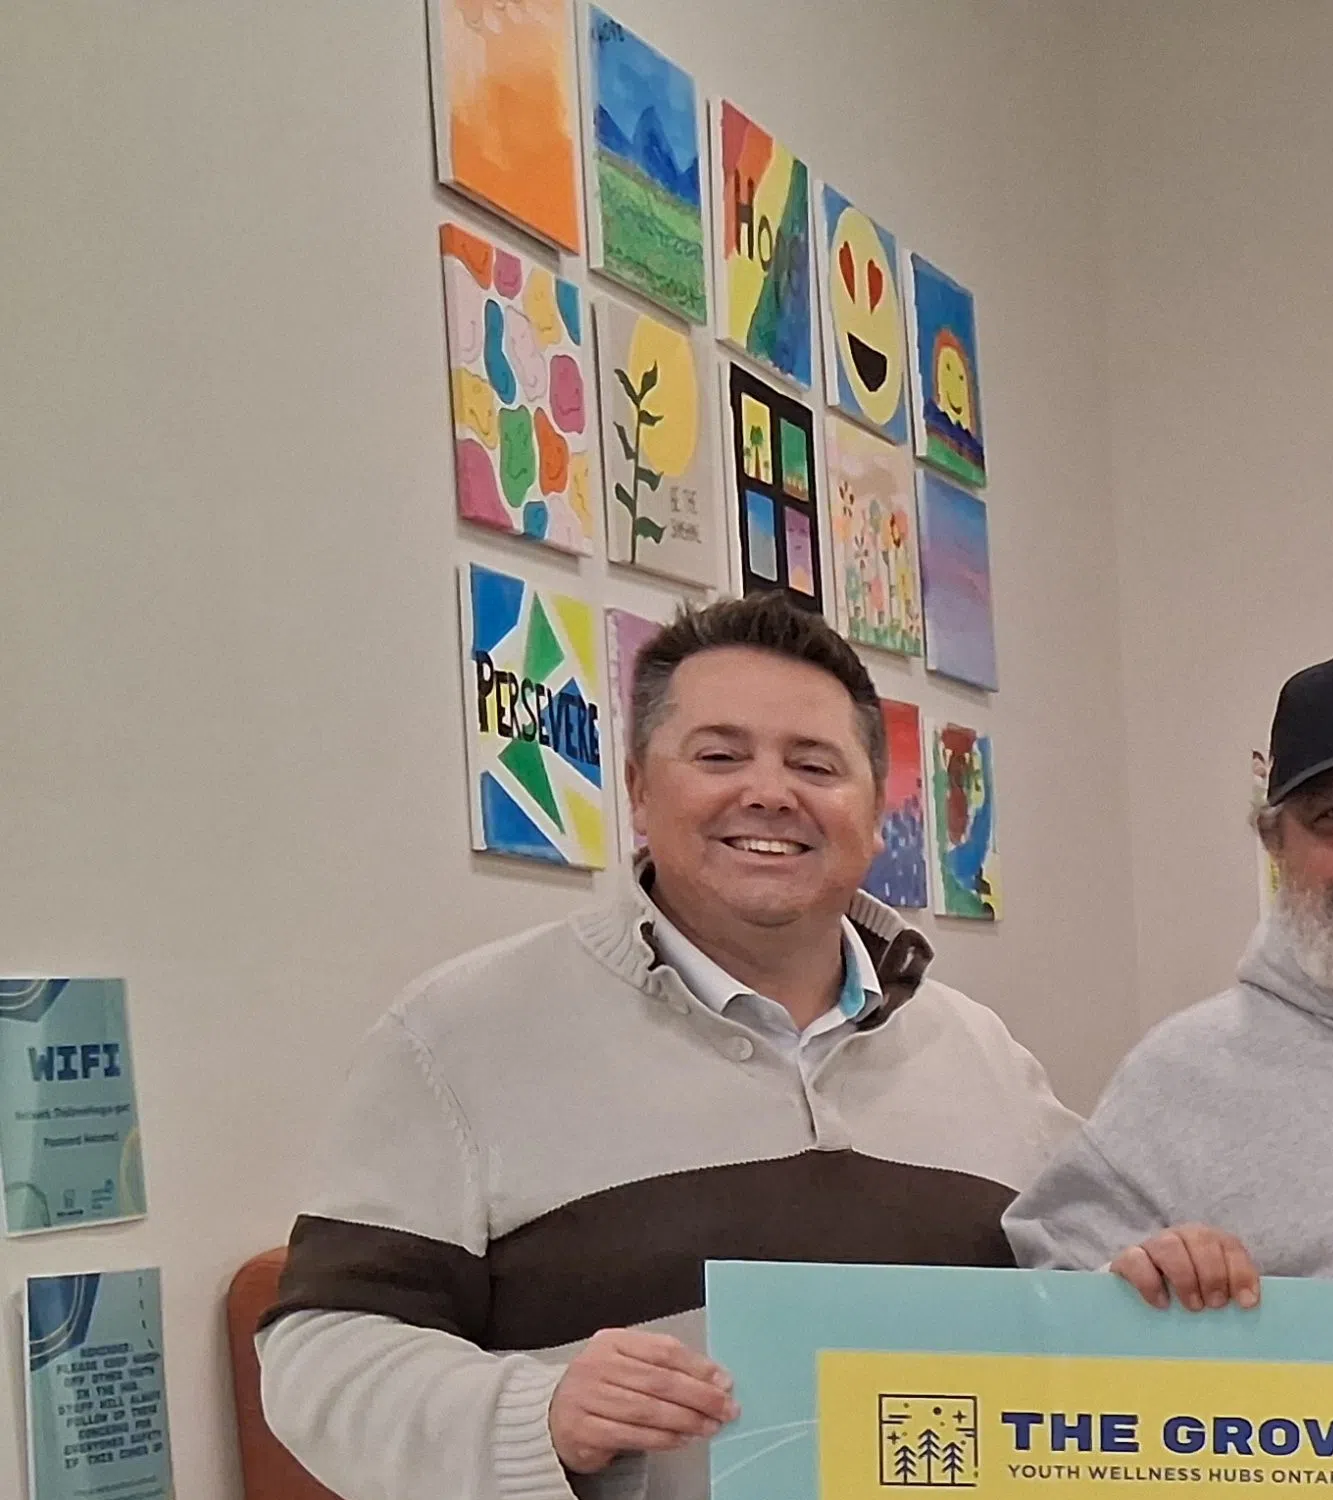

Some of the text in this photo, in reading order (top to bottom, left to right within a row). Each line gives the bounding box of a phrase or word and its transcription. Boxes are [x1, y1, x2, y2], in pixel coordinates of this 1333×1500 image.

[475, 650, 600, 767] PERSEVERE
[28, 1043, 121, 1081] WIFI
[1001, 1410, 1140, 1453] THE
[1007, 1464, 1081, 1481] YOUTH
[1087, 1465, 1202, 1483] WELLNESS
[1209, 1468, 1264, 1483] HUBS
